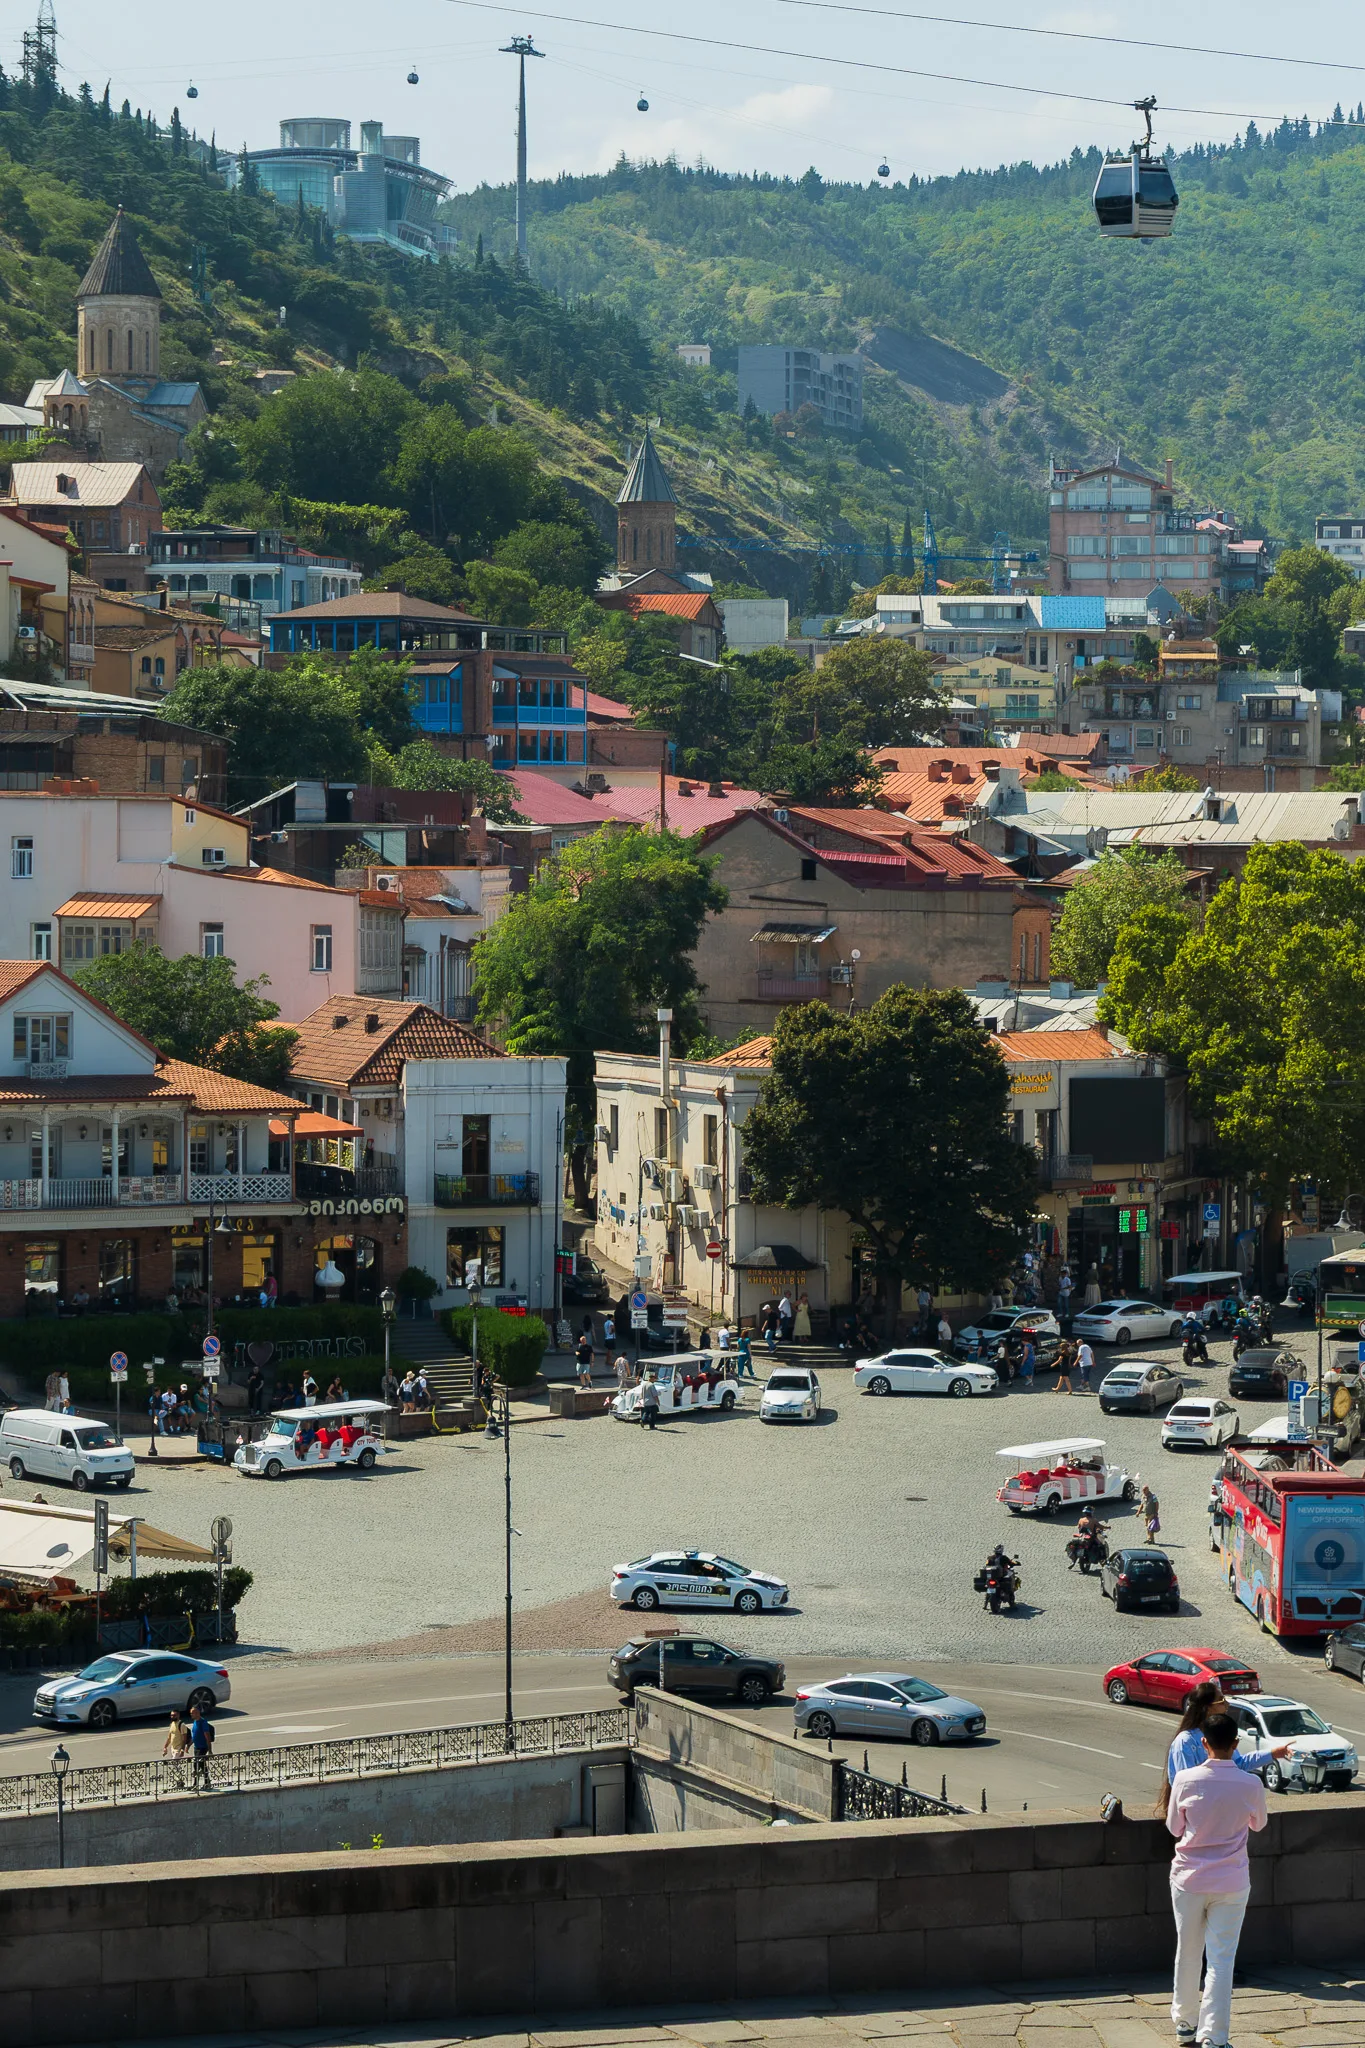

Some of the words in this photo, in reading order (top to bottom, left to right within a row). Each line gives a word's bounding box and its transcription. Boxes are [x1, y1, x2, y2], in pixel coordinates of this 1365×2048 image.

[1007, 1071, 1053, 1085] aharajah
[1010, 1085, 1049, 1094] RESTAURANT
[747, 1276, 787, 1285] KHINKALI
[1292, 1383, 1304, 1400] P
[665, 1583, 713, 1594] პოლიცია
